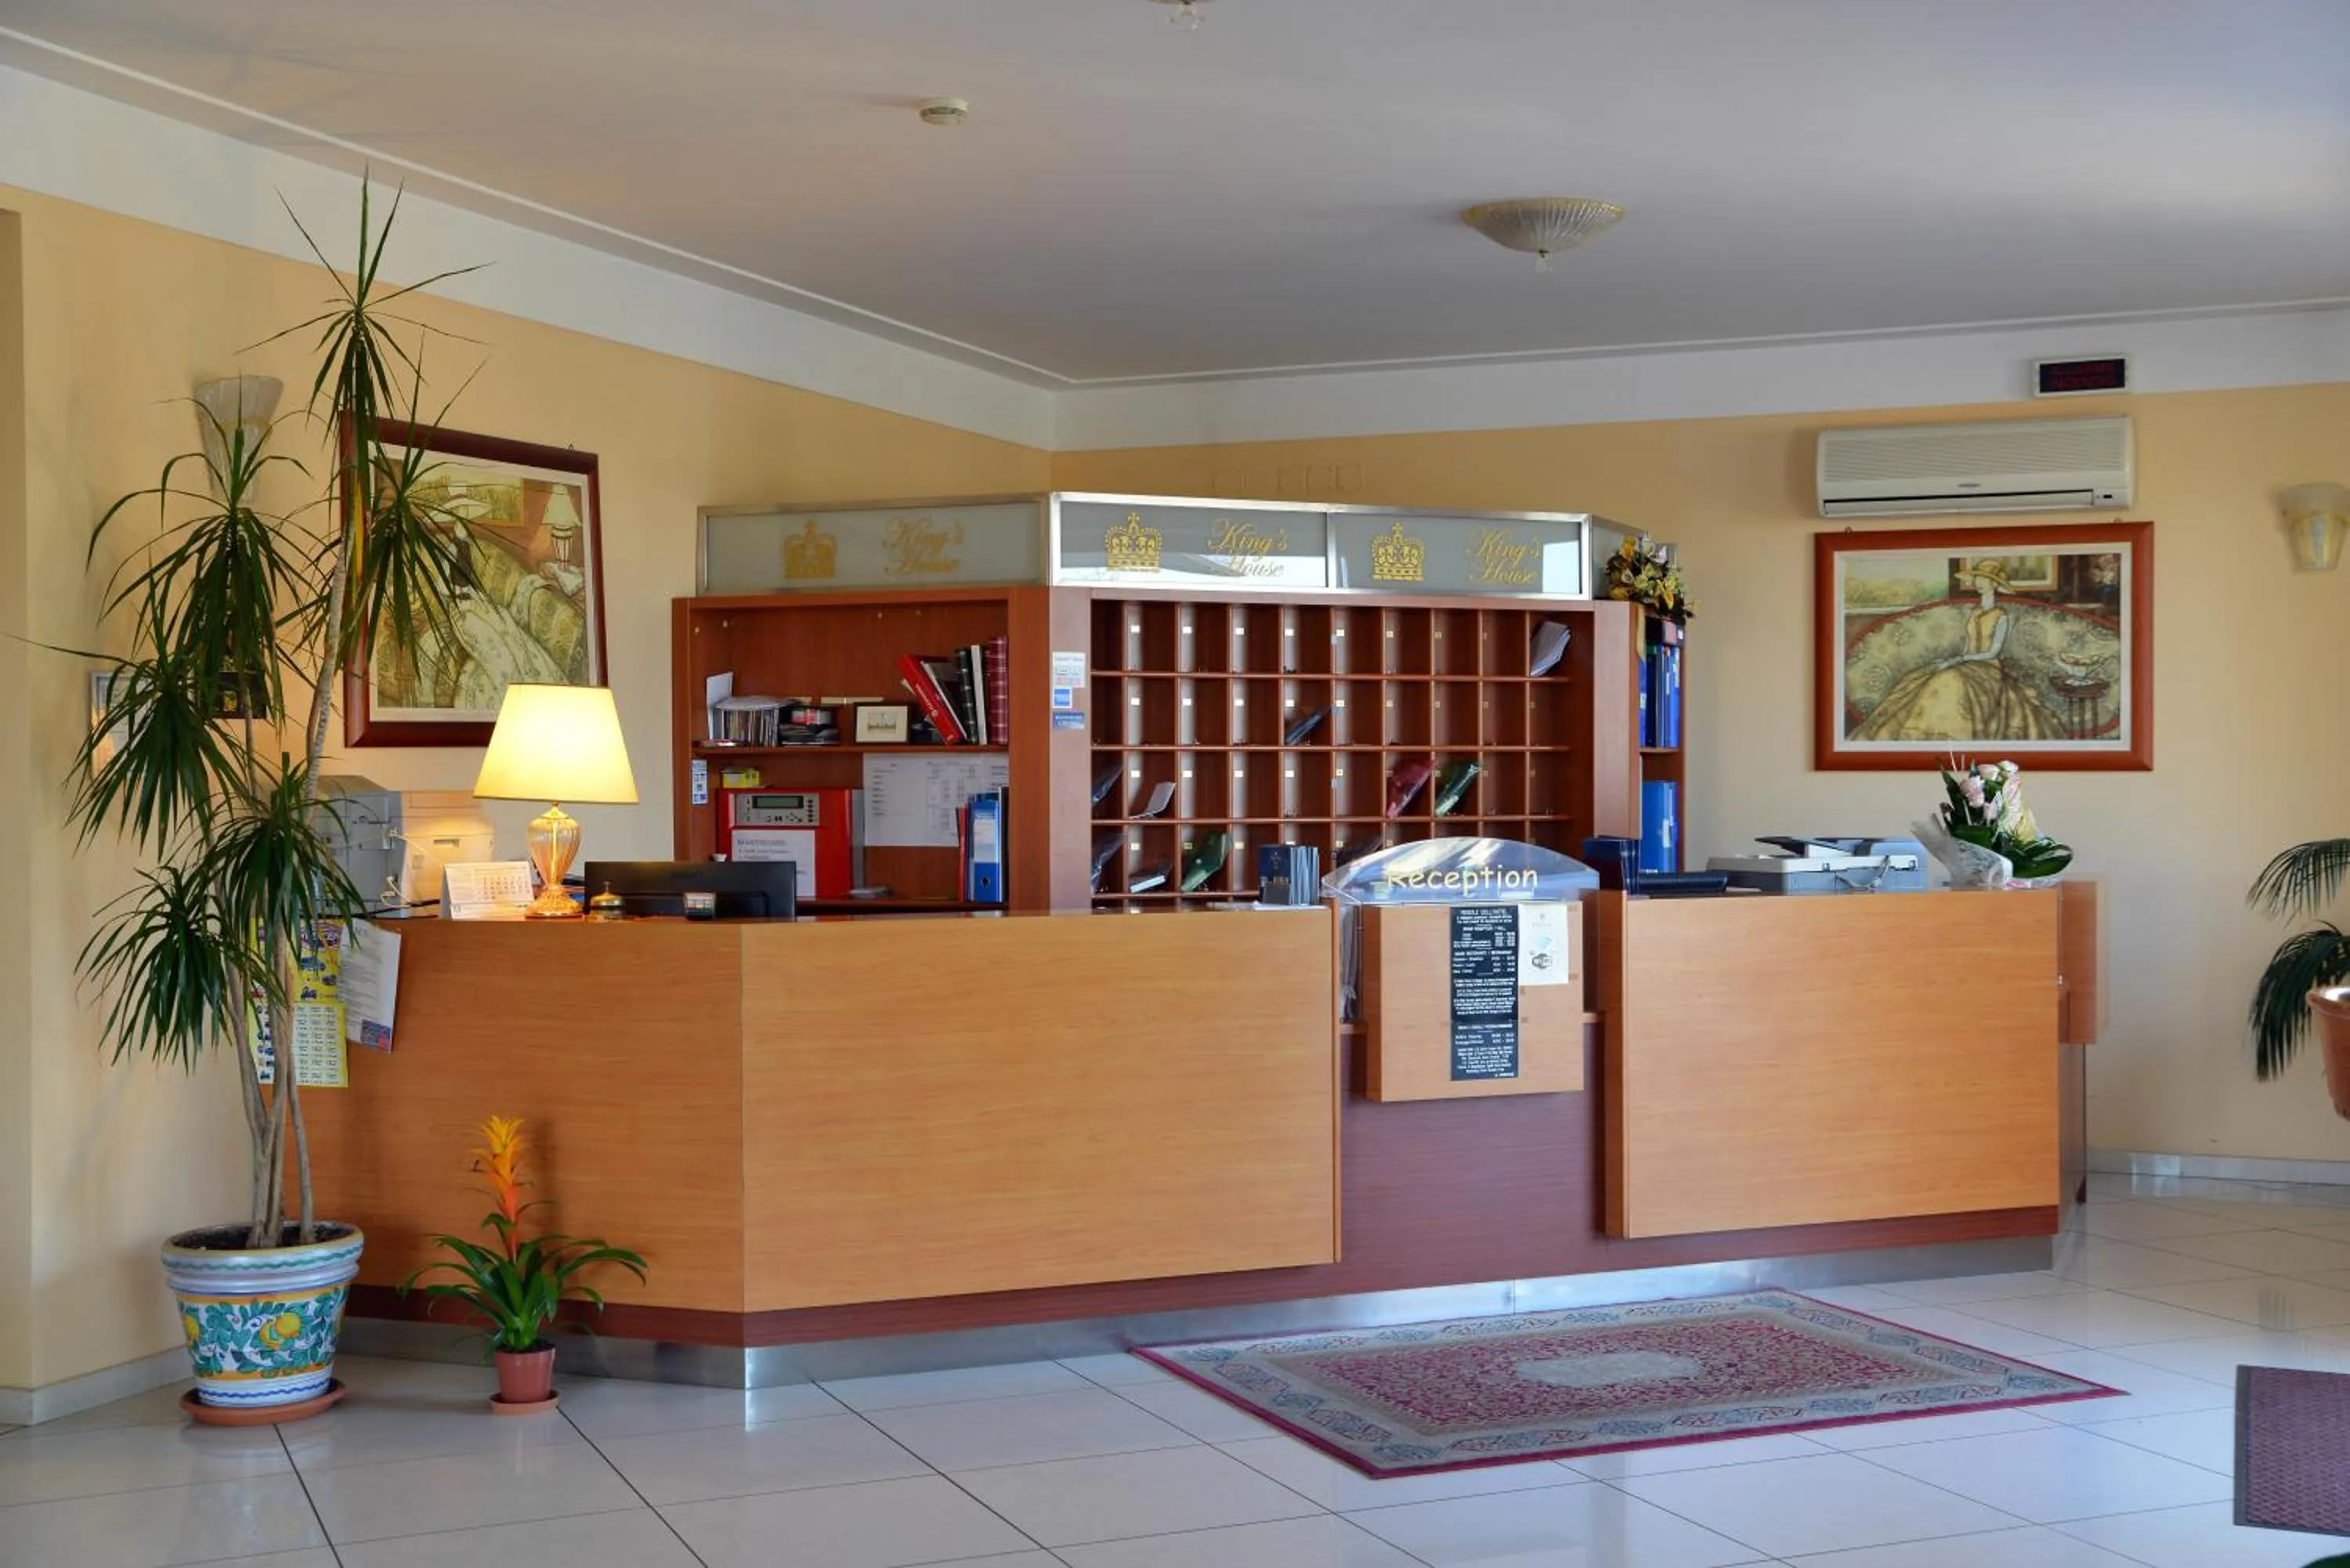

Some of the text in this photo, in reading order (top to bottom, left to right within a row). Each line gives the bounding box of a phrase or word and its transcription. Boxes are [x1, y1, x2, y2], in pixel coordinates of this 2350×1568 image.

[1206, 517, 1289, 562] King's
[1464, 527, 1542, 568] King's
[1209, 549, 1285, 577] House
[1467, 557, 1539, 584] House
[1386, 865, 1538, 898] Reception
